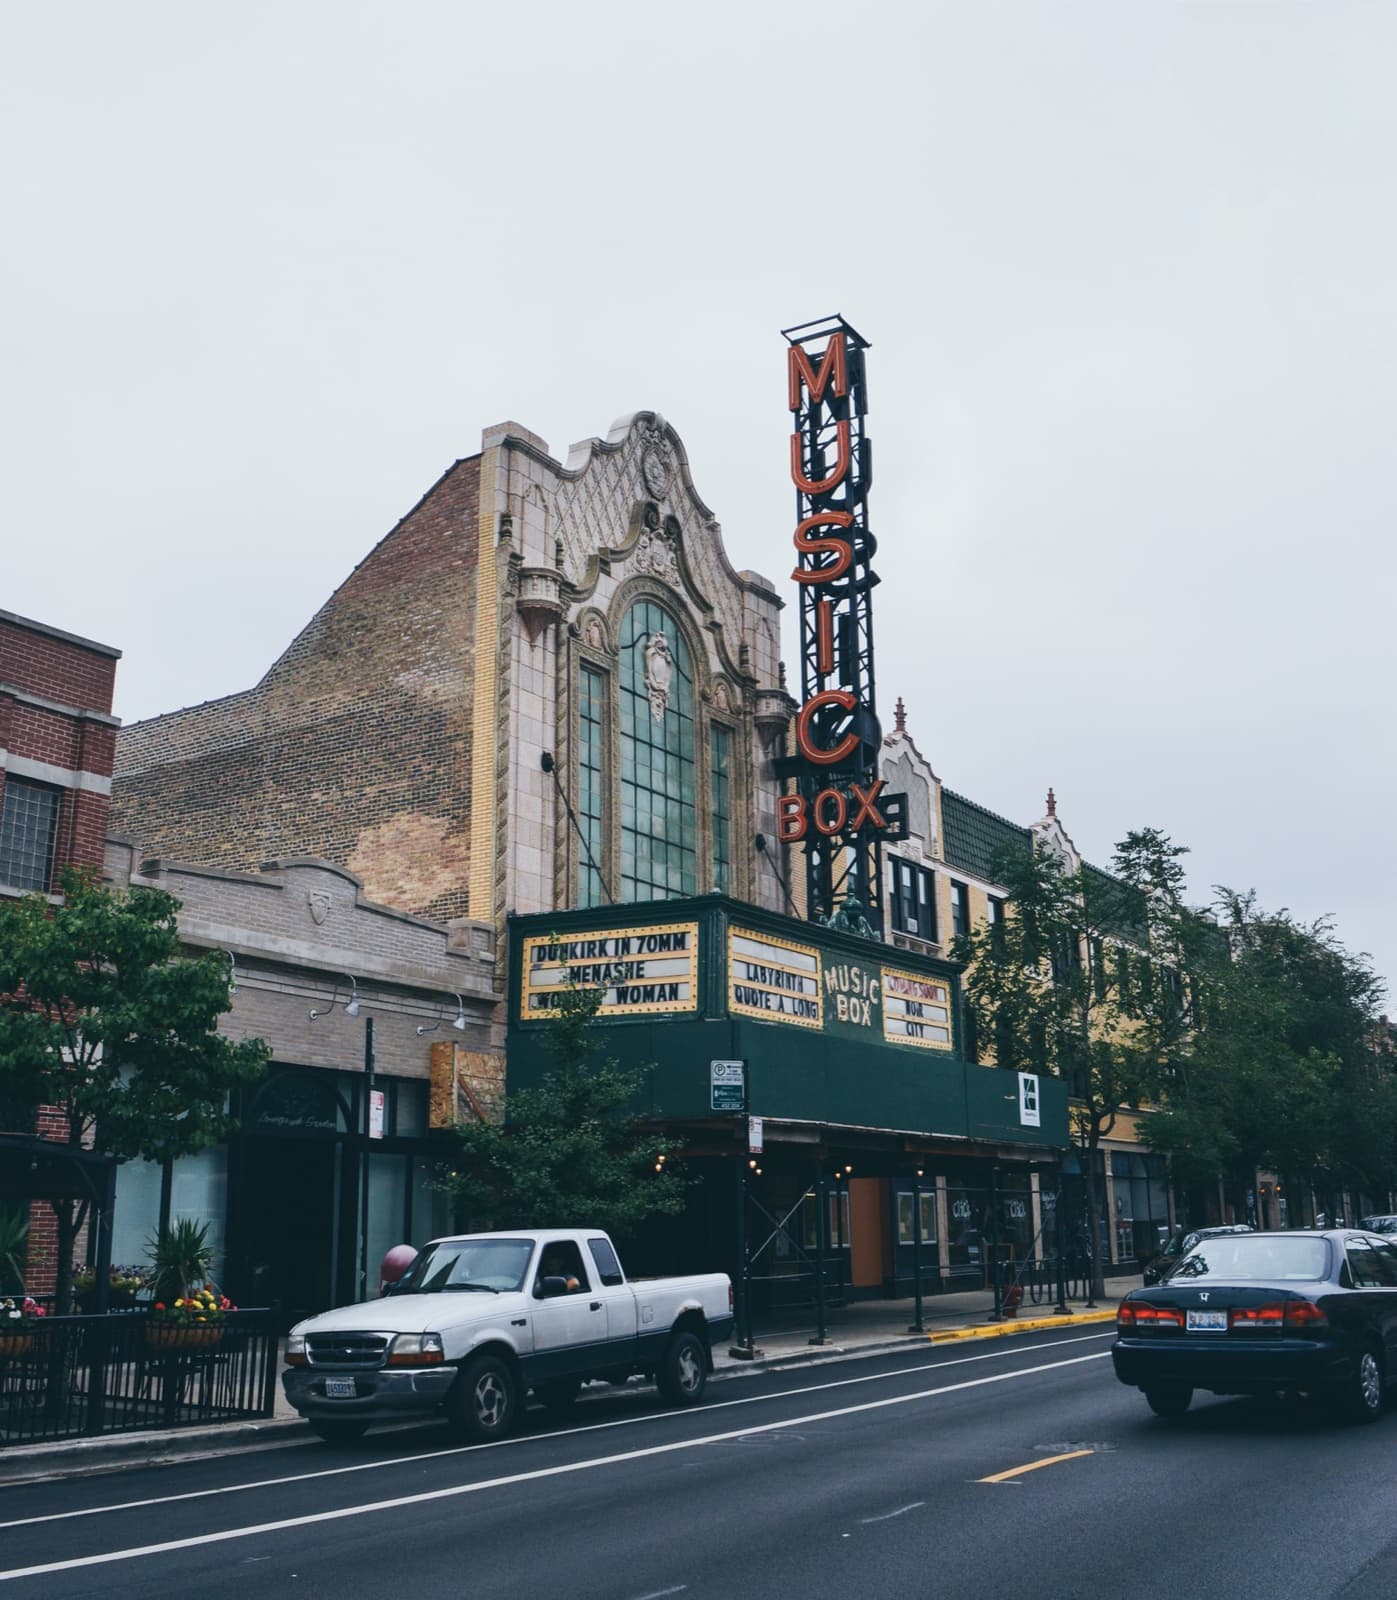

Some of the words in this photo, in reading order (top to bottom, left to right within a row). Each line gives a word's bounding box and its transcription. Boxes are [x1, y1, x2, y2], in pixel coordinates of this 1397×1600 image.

[788, 332, 858, 765] MUSIC
[777, 780, 887, 842] BOX
[614, 936, 631, 956] IN
[637, 932, 686, 953] 70MM
[570, 961, 645, 983] MENASHE
[824, 965, 879, 1004] MUSIC
[616, 983, 679, 1004] WOMAN
[735, 986, 771, 1009] QUOTE
[778, 996, 785, 1013] A
[793, 998, 816, 1018] LONG
[836, 994, 871, 1026] BOX
[906, 1022, 924, 1038] CITY
